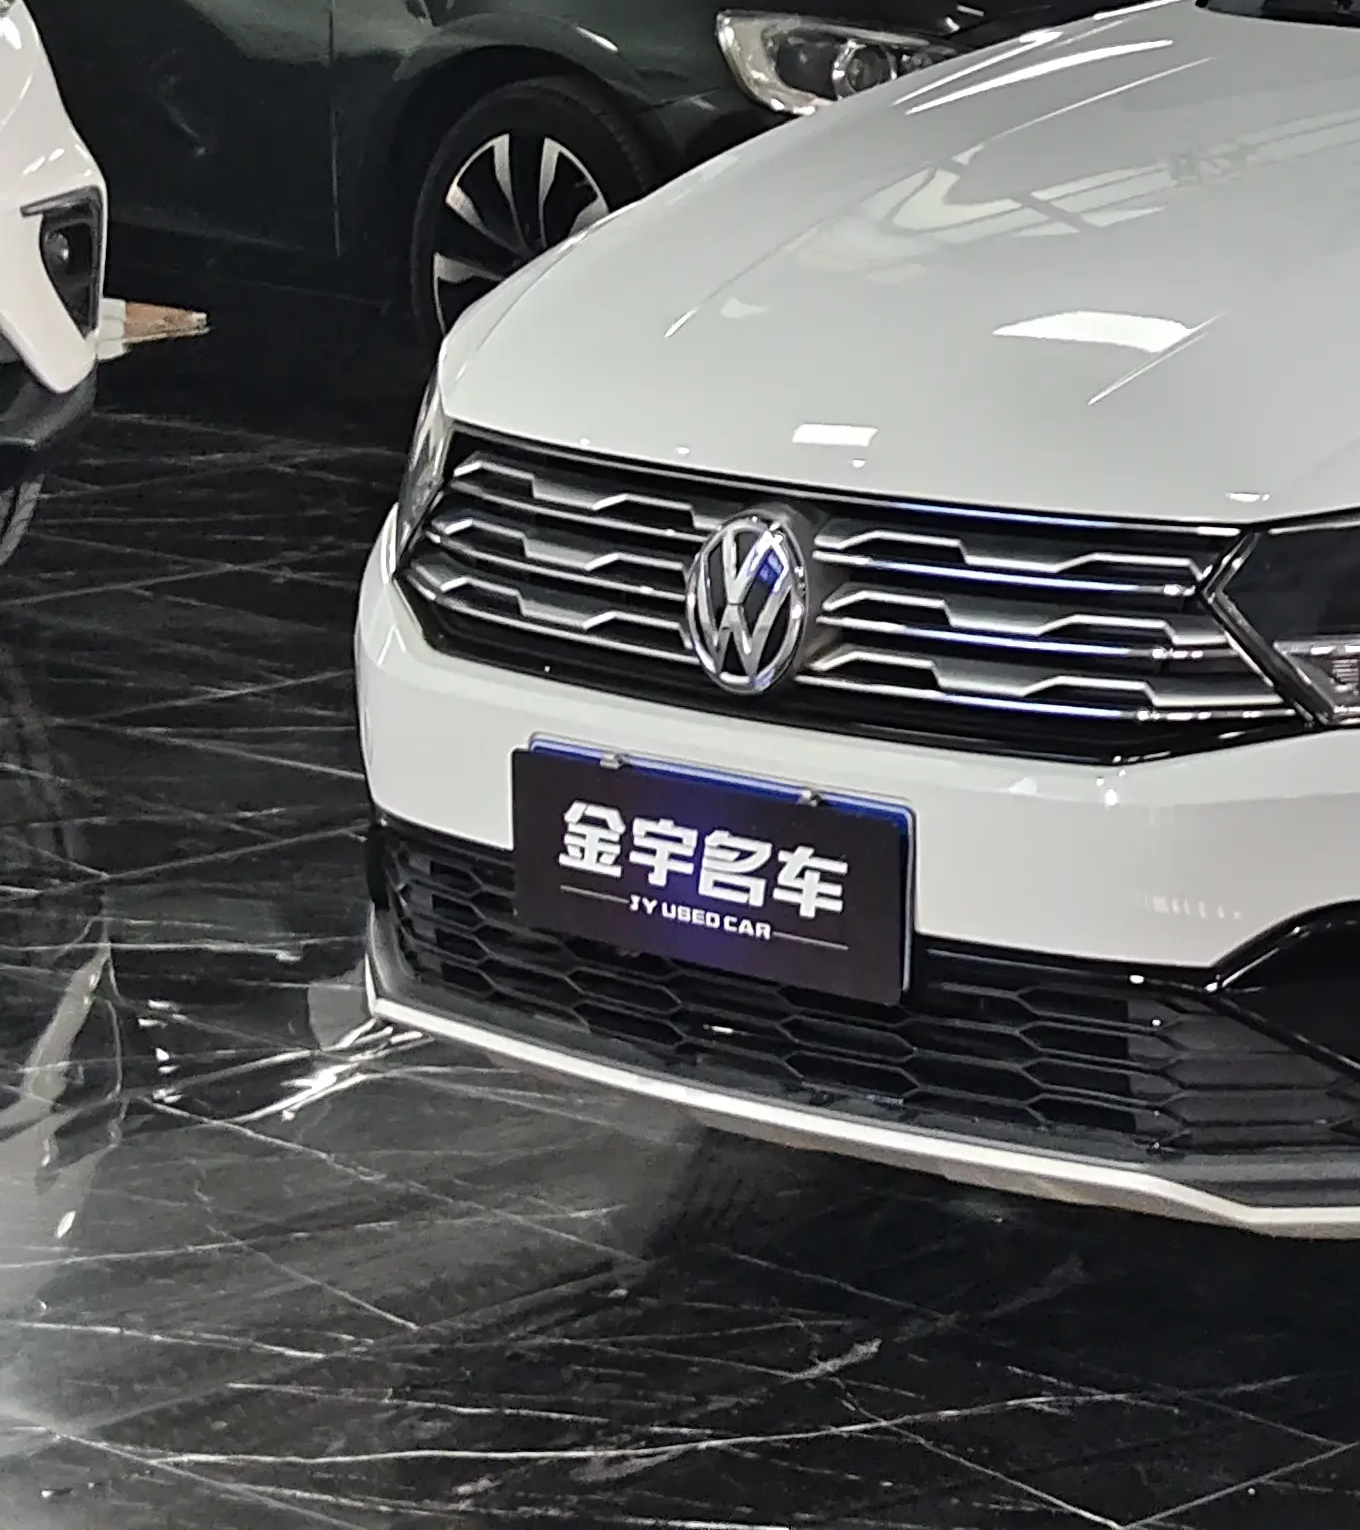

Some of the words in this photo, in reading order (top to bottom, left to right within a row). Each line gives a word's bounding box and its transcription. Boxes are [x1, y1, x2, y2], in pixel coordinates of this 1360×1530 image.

[558, 799, 848, 920] 金宇名车
[723, 915, 772, 941] CAR
